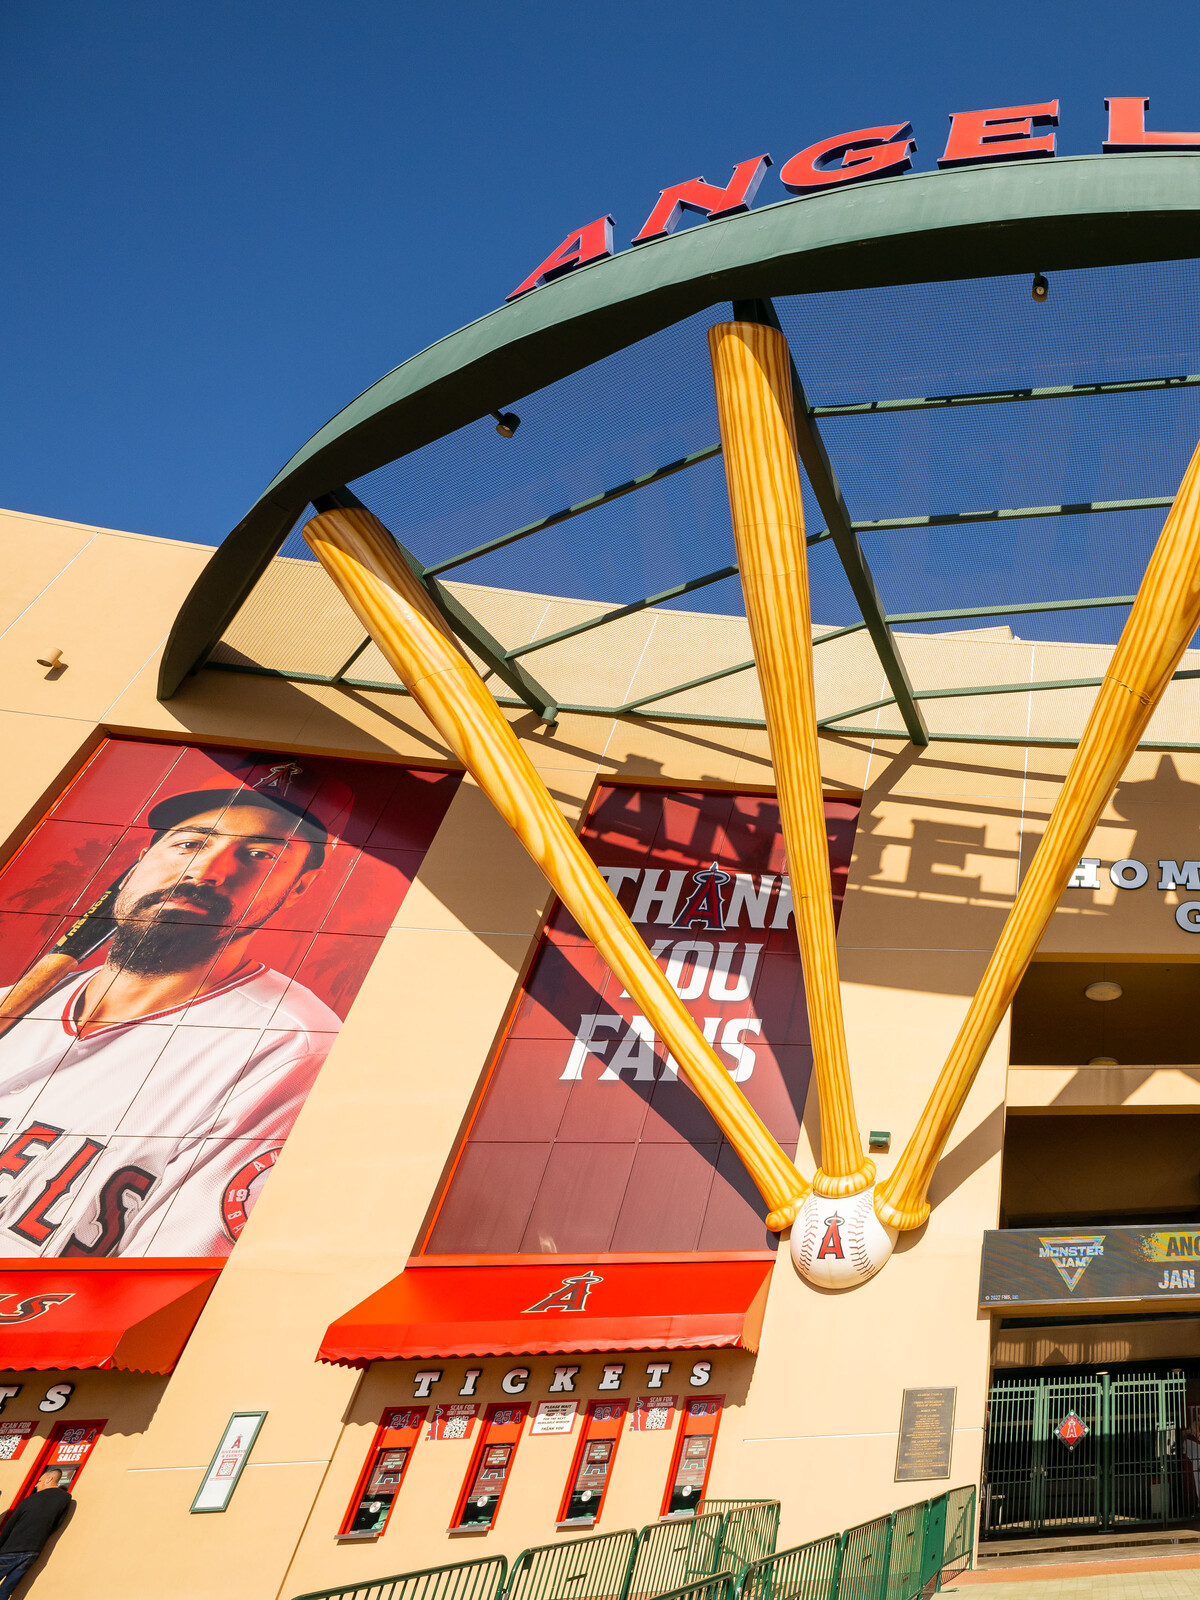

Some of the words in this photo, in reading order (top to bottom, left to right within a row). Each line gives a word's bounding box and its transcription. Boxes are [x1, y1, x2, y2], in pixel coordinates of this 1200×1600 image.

[228, 1189, 248, 1202] 19
[1039, 1246, 1104, 1257] MONSTER
[1055, 1257, 1086, 1268] JAM
[1158, 1269, 1195, 1289] JAN
[412, 1360, 713, 1398] TICKETS
[593, 1406, 613, 1420] 26
[690, 1402, 709, 1416] 27
[391, 1414, 411, 1428] 24
[493, 1410, 513, 1424] 25
[62, 1428, 86, 1443] 23
[58, 1445, 91, 1454] TICKET
[57, 1454, 82, 1462] SALES
